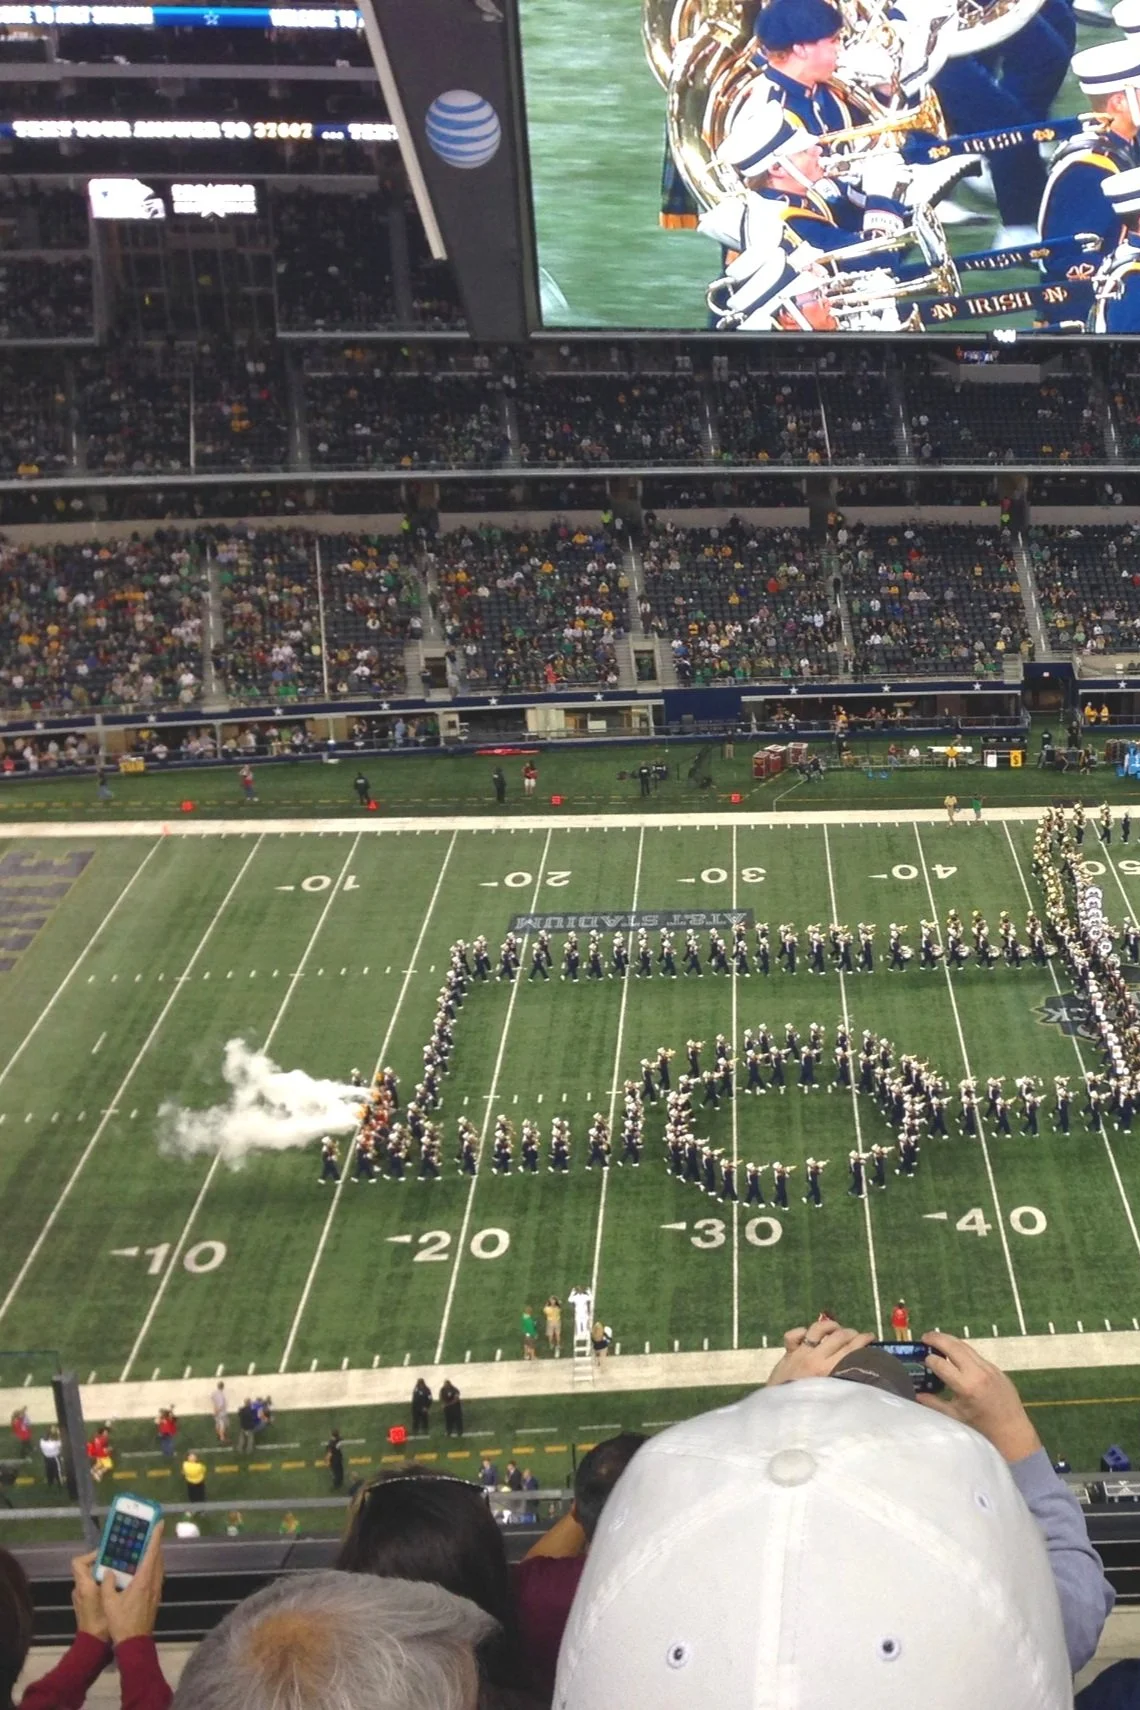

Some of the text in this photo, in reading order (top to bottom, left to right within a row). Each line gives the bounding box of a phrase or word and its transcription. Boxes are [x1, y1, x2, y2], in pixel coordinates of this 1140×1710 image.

[963, 131, 1023, 153] IRISH
[966, 290, 1033, 314] IRISH
[514, 912, 748, 930] AT&T STADIUM
[690, 1216, 783, 1250] 30
[955, 1205, 1048, 1237] 40
[143, 1240, 227, 1276] 10
[413, 1227, 510, 1263] 20
